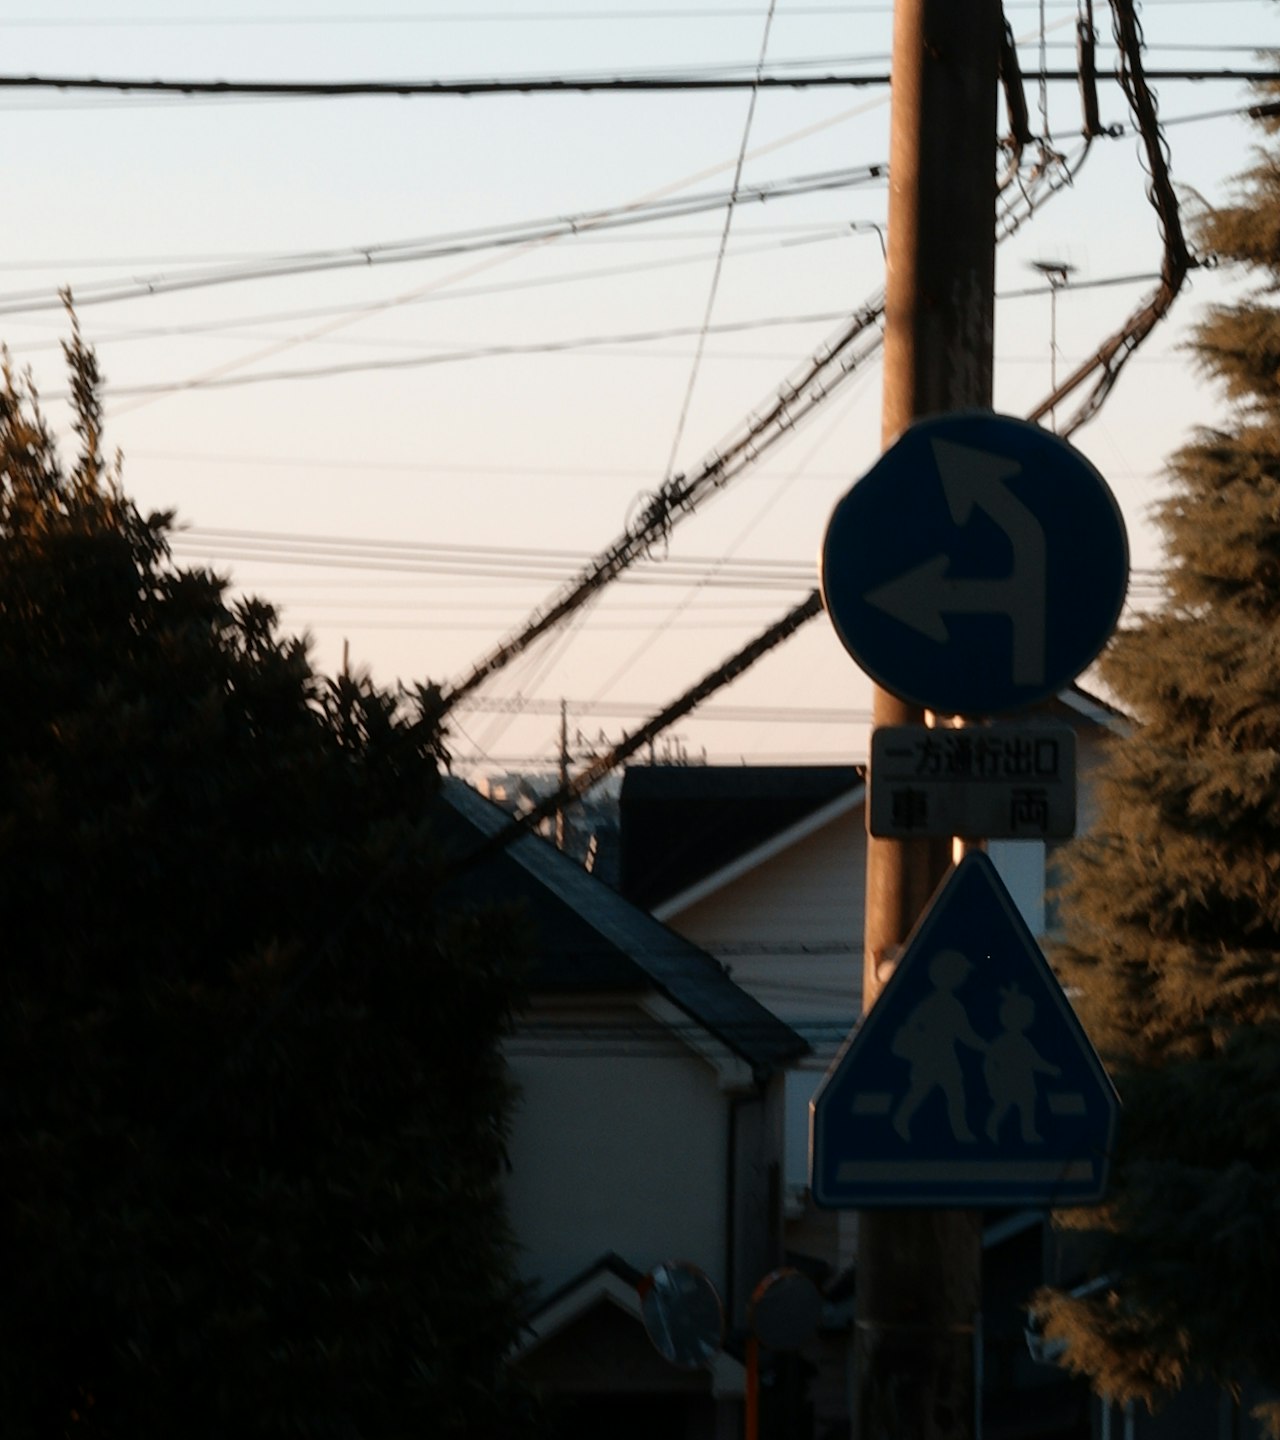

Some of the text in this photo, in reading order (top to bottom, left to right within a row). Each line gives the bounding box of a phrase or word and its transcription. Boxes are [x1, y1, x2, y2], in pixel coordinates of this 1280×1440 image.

[885, 735, 1059, 775] 一方通行出口
